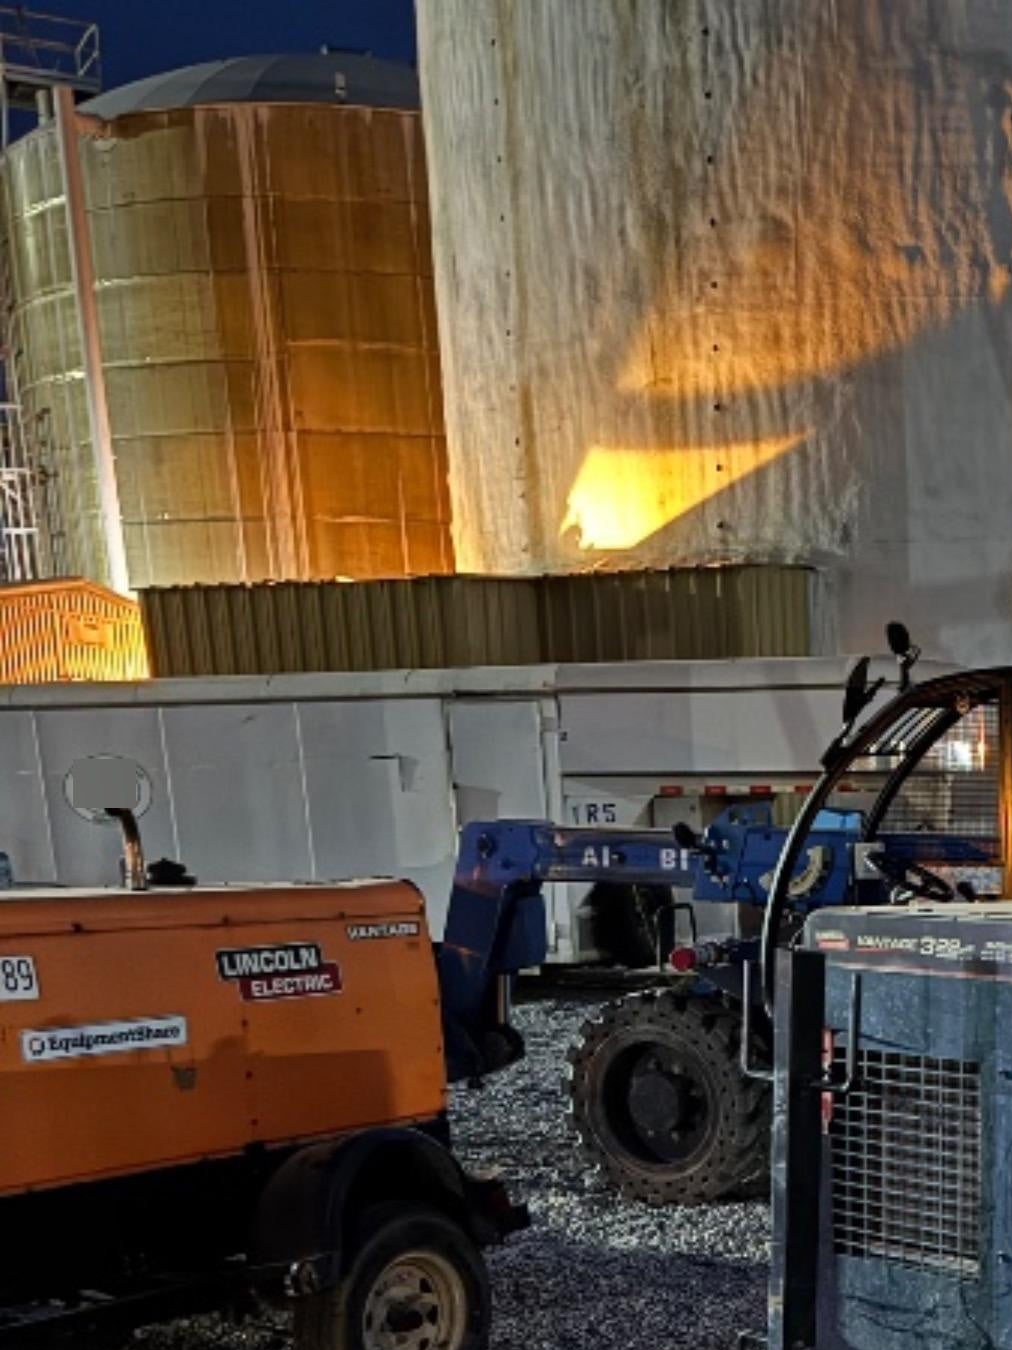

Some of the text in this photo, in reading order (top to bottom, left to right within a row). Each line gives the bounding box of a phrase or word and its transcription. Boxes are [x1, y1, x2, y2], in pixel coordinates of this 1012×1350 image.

[222, 947, 319, 977] LINCOLN
[250, 973, 334, 998] ELECTRIC
[48, 1025, 181, 1053] EquipmentShare
